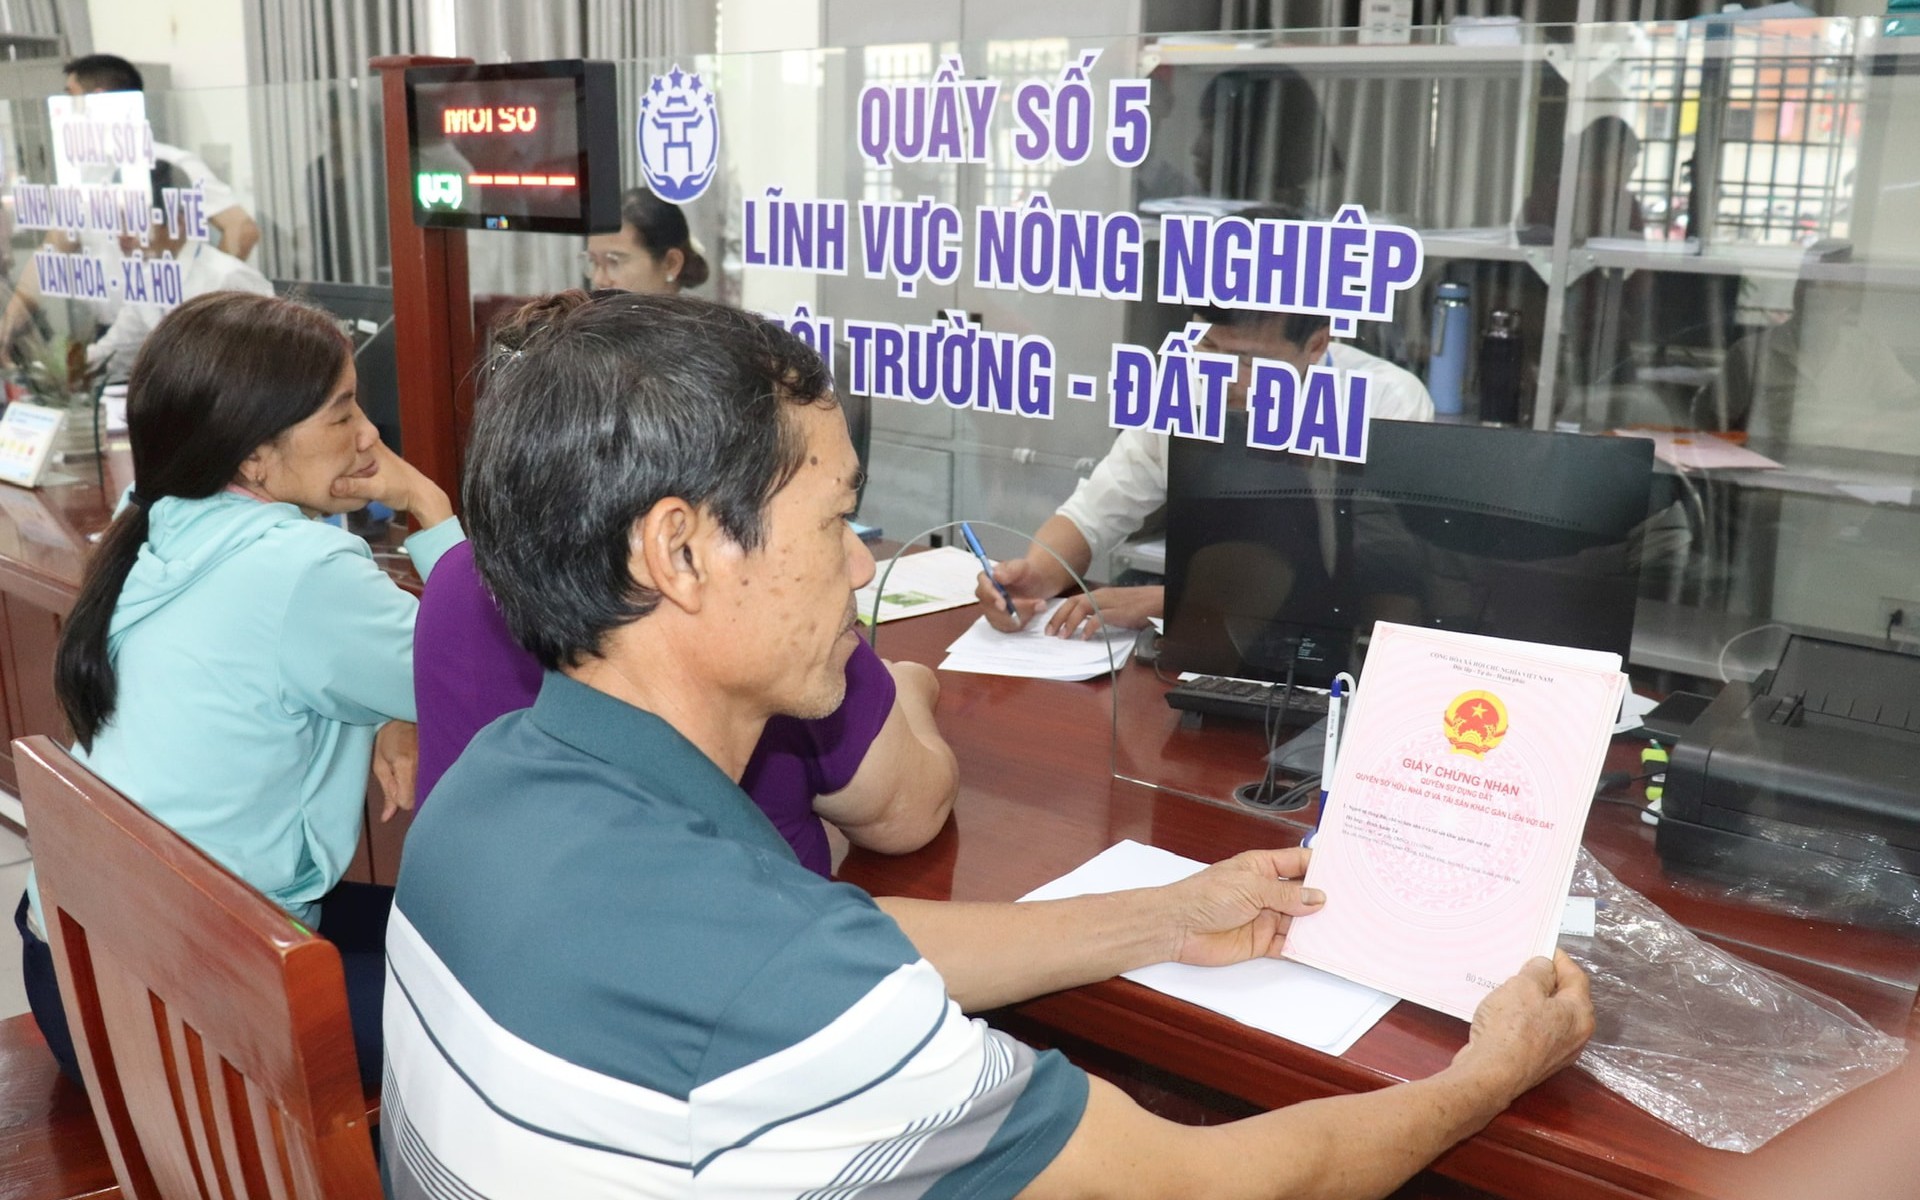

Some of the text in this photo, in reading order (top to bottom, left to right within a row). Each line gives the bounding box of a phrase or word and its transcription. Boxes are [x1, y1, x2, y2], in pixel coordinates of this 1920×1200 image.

[859, 53, 1150, 167] QUẦY SỐ 5
[124, 190, 148, 244] VỤ
[165, 191, 179, 237] Y
[182, 178, 208, 238] TẾ
[743, 185, 1420, 333] LĨNH VỰC NÔNG NGHIỆP
[122, 252, 148, 302] XÃ
[846, 312, 1053, 418] TRƯỜNG
[1070, 378, 1094, 399] -
[1111, 327, 1235, 440] ĐẤT
[1251, 364, 1370, 461] ĐAI
